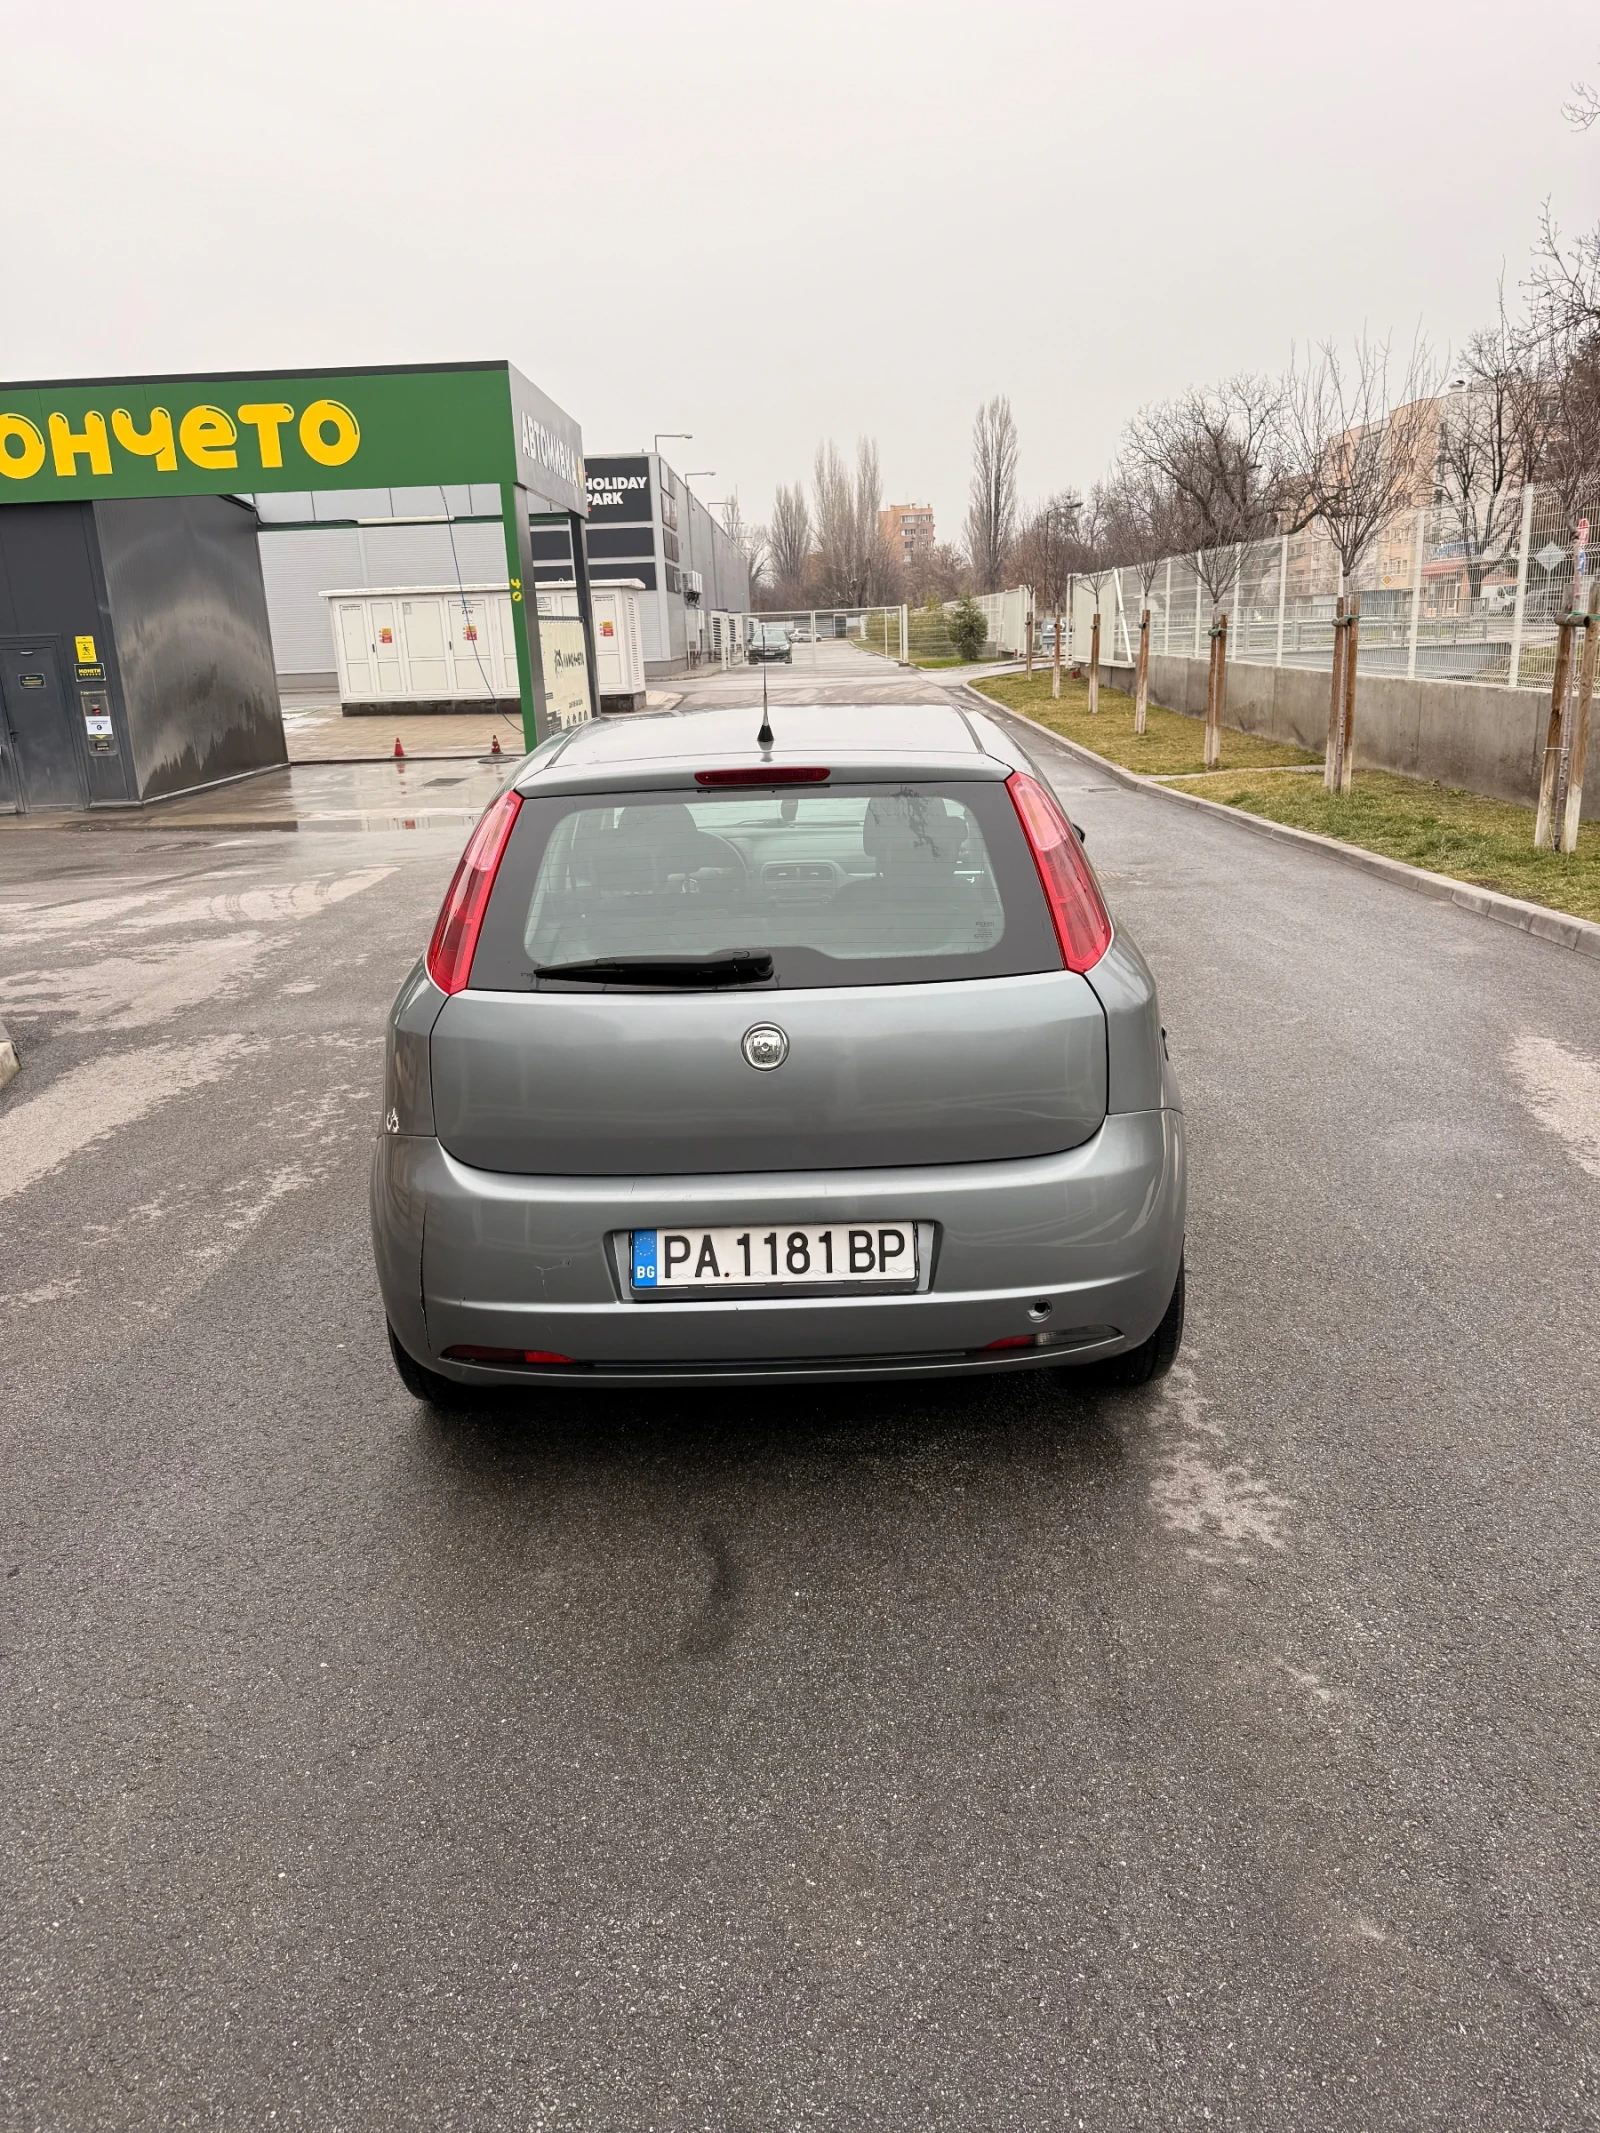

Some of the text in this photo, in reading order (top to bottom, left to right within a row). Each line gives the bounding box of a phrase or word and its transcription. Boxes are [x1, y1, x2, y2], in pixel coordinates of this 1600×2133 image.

[521, 411, 579, 489] АВТОМИВКА
[585, 476, 648, 491] HOLIDAY
[586, 491, 624, 506] PARK
[636, 1265, 655, 1279] BG
